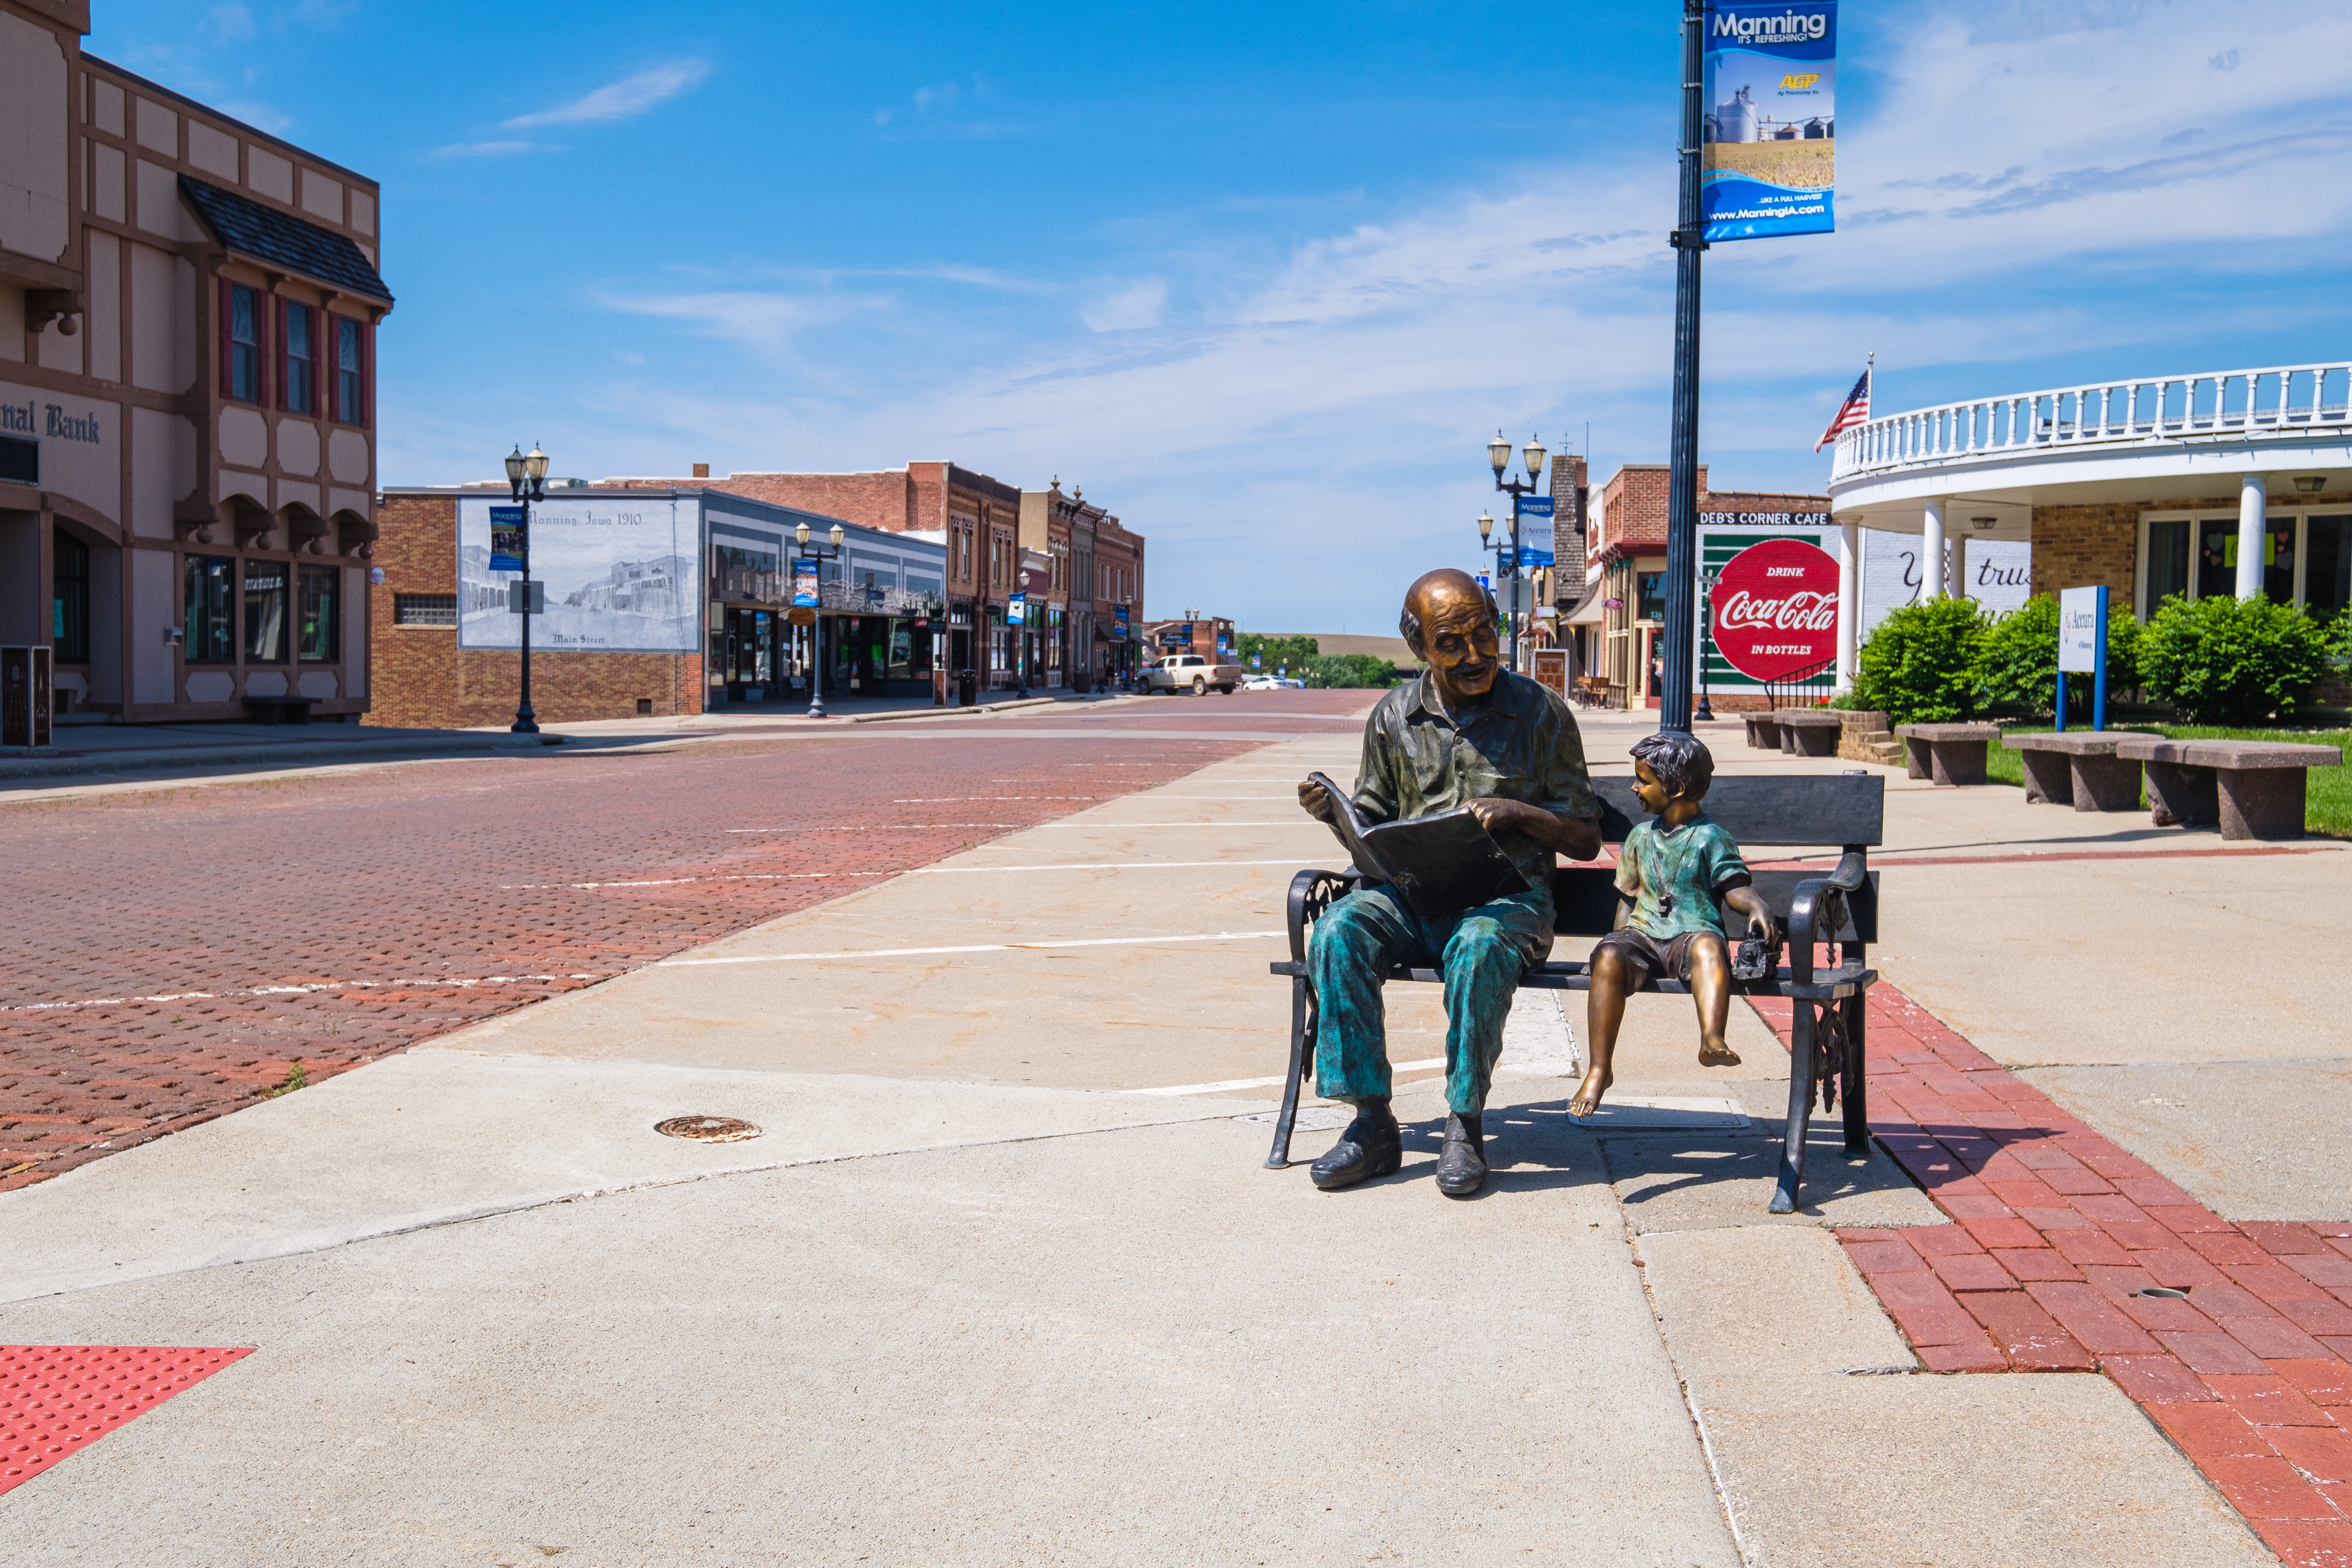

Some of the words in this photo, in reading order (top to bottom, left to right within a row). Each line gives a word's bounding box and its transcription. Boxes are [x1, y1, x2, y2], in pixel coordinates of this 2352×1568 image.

[1713, 9, 1826, 38] Manning
[1738, 36, 1751, 44] IT'S
[1755, 33, 1808, 43] REFRESHING!
[1778, 73, 1819, 89] AGP
[1709, 205, 1824, 220] www.ManningIA.com
[0, 400, 36, 432] nal
[45, 403, 101, 445] Bank
[1521, 503, 1551, 512] Manning
[584, 510, 612, 525] Iowa
[618, 513, 642, 525] 1910
[1700, 512, 1735, 524] DEB'S
[1739, 512, 1791, 524] CORNER
[1795, 513, 1827, 524] CAFE
[1766, 567, 1805, 577] DRINK
[1720, 591, 1839, 630] Coca-Cola
[2072, 609, 2094, 629] Accura
[553, 634, 577, 644] Main
[580, 634, 604, 643] Street
[1751, 645, 1764, 654] IN
[1765, 645, 1812, 655] BOTTLES
